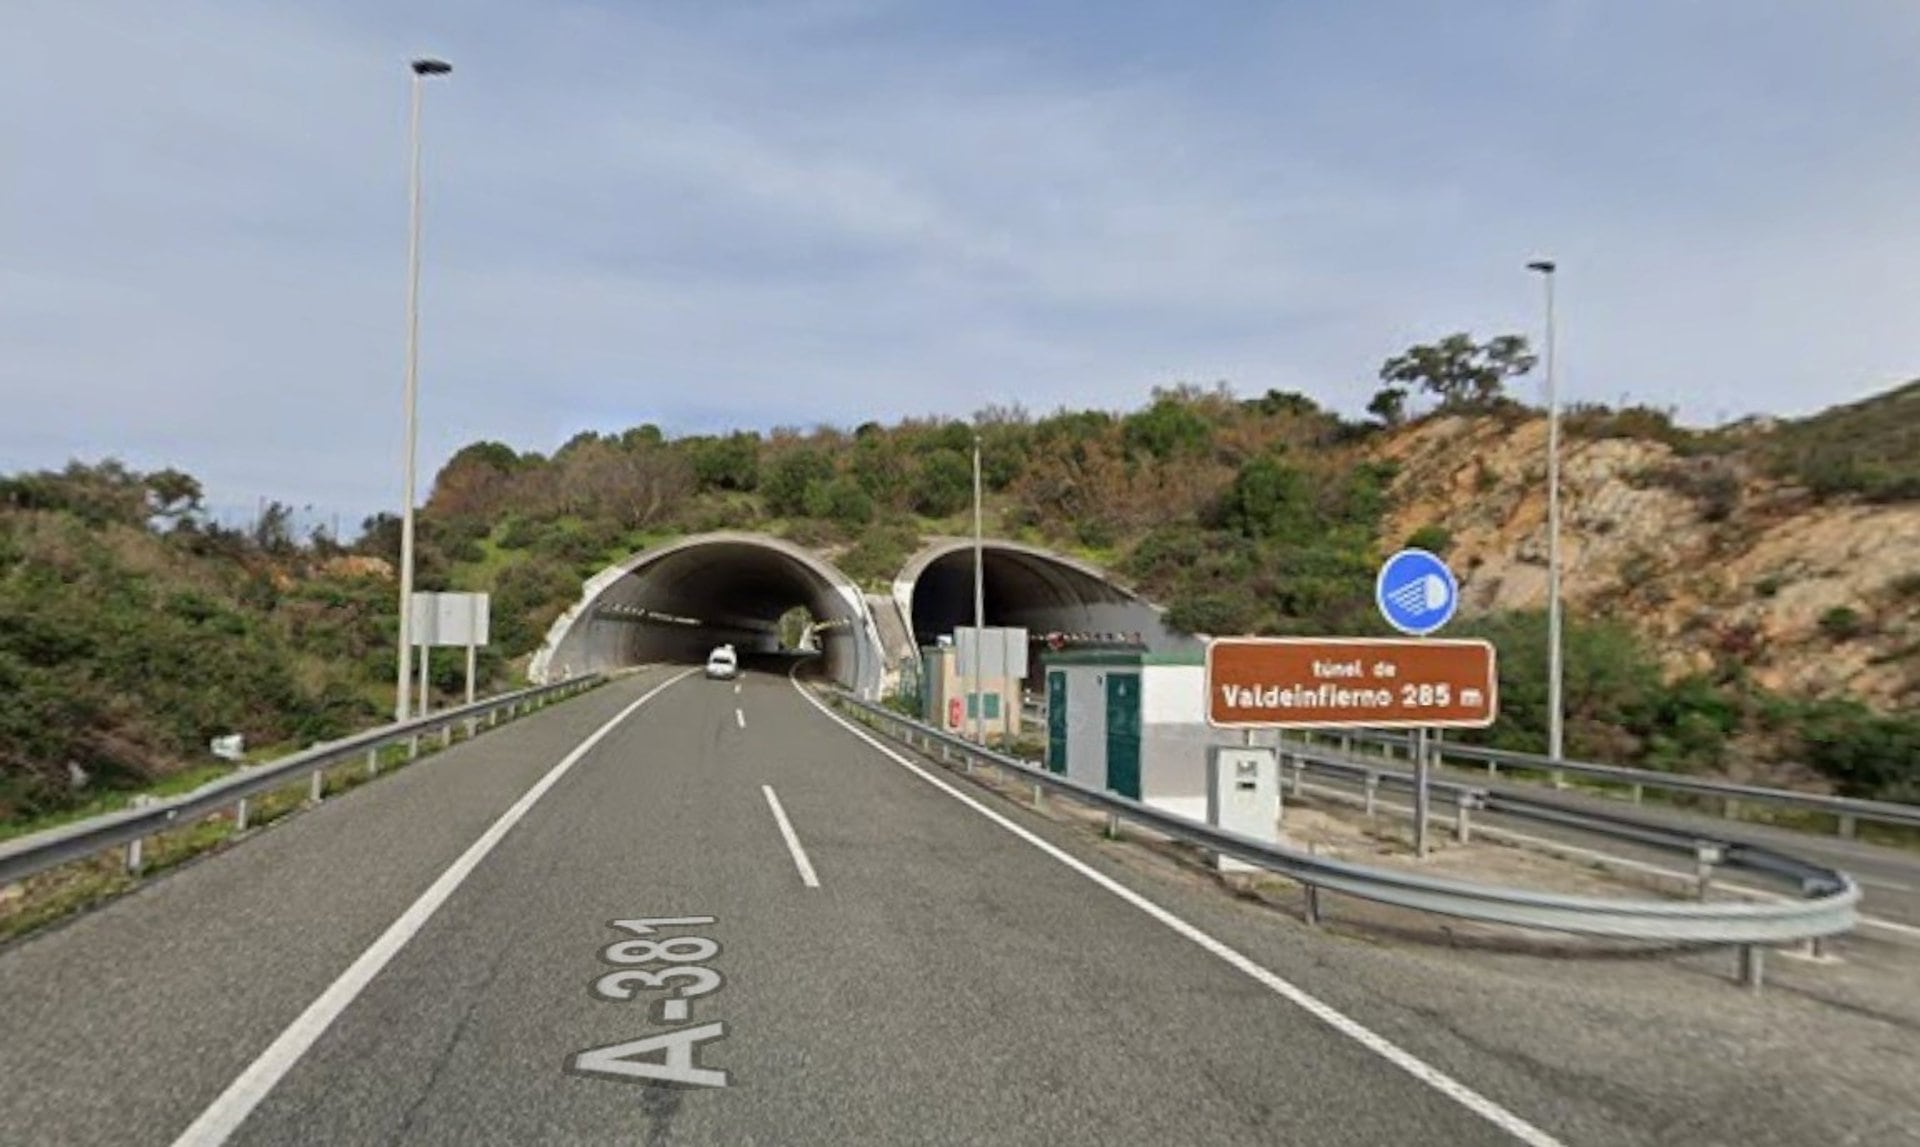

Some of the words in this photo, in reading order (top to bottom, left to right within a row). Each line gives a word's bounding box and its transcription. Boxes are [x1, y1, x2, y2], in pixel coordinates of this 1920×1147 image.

[1373, 659, 1396, 678] de
[1222, 684, 1392, 708] Valdeinfierno
[1400, 683, 1451, 707] 285
[1459, 688, 1483, 707] m
